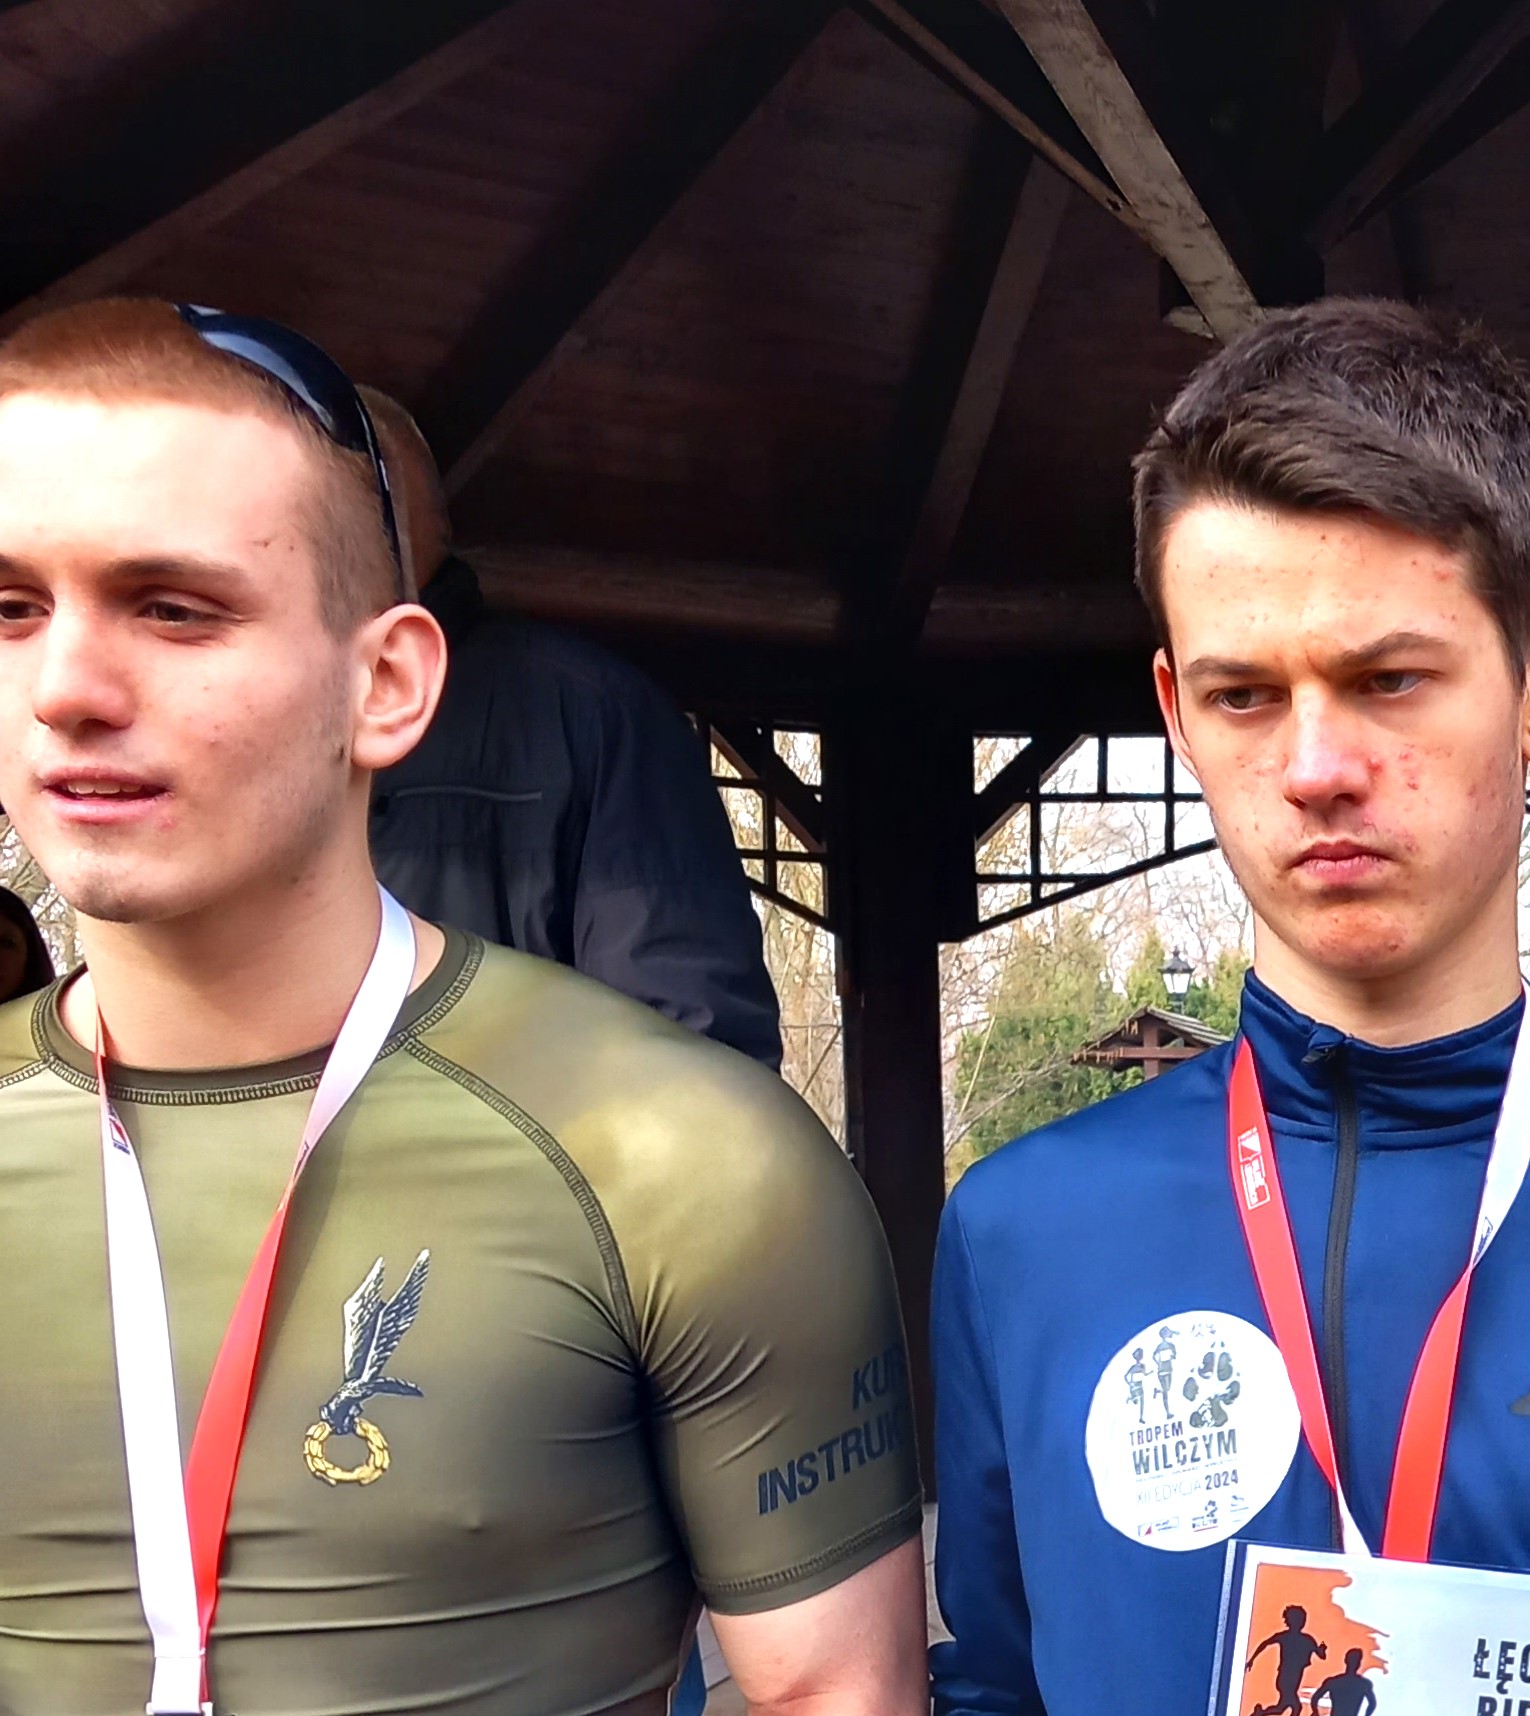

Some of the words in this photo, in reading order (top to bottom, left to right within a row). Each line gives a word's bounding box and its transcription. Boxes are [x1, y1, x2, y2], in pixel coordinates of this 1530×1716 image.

[1129, 1421, 1184, 1446] TROPEM
[1132, 1428, 1237, 1475] WILCZYM
[1205, 1469, 1239, 1491] 2024
